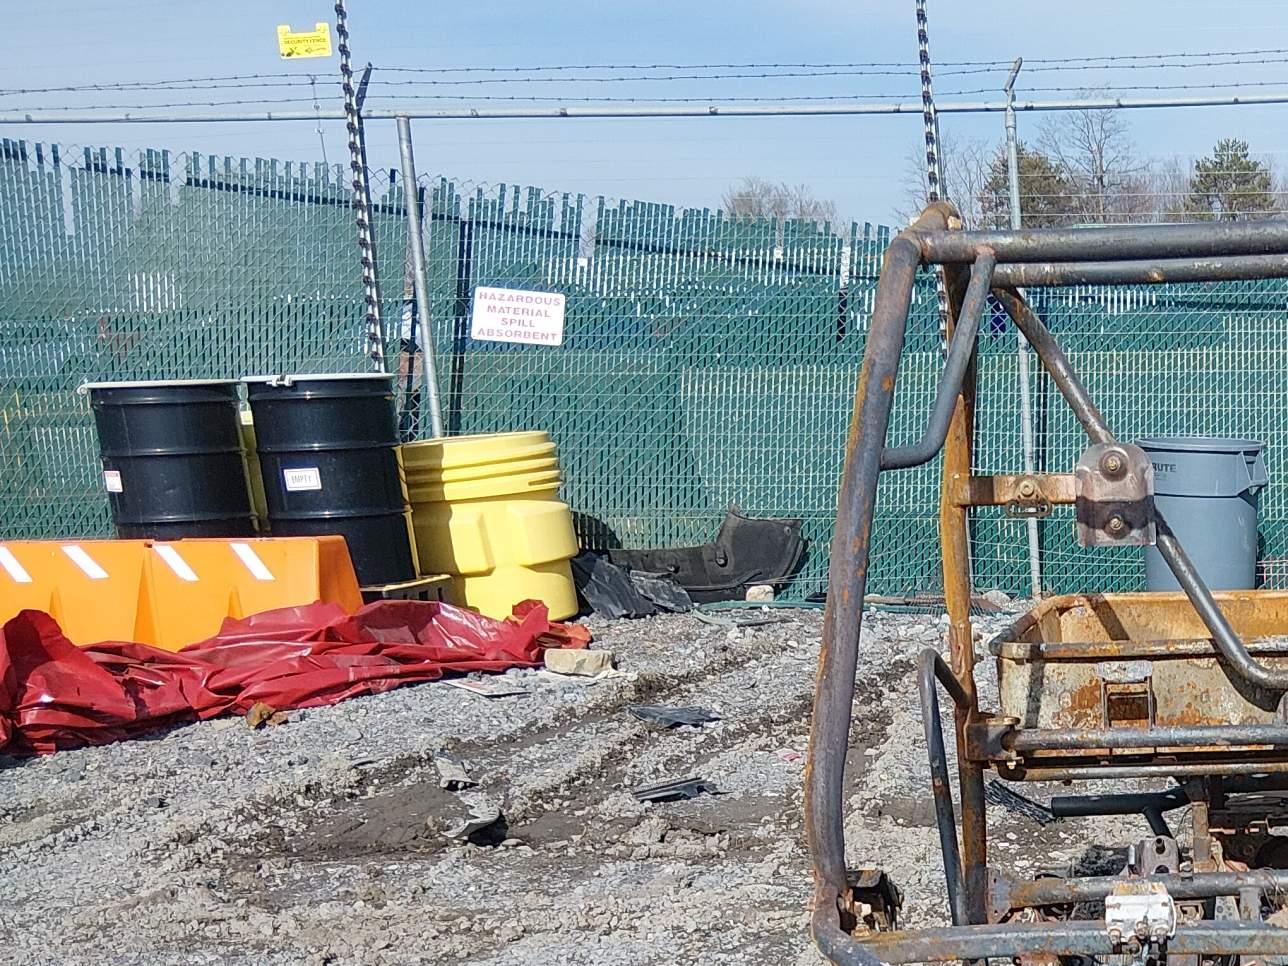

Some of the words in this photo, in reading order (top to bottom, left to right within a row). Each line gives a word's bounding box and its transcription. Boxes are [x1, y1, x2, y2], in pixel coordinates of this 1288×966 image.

[479, 291, 561, 306] HAZARDOUS
[487, 305, 551, 318] MATERIAL
[501, 317, 536, 328] SPILL
[478, 328, 559, 341] ABSORBENT
[1152, 462, 1176, 472] RUTE
